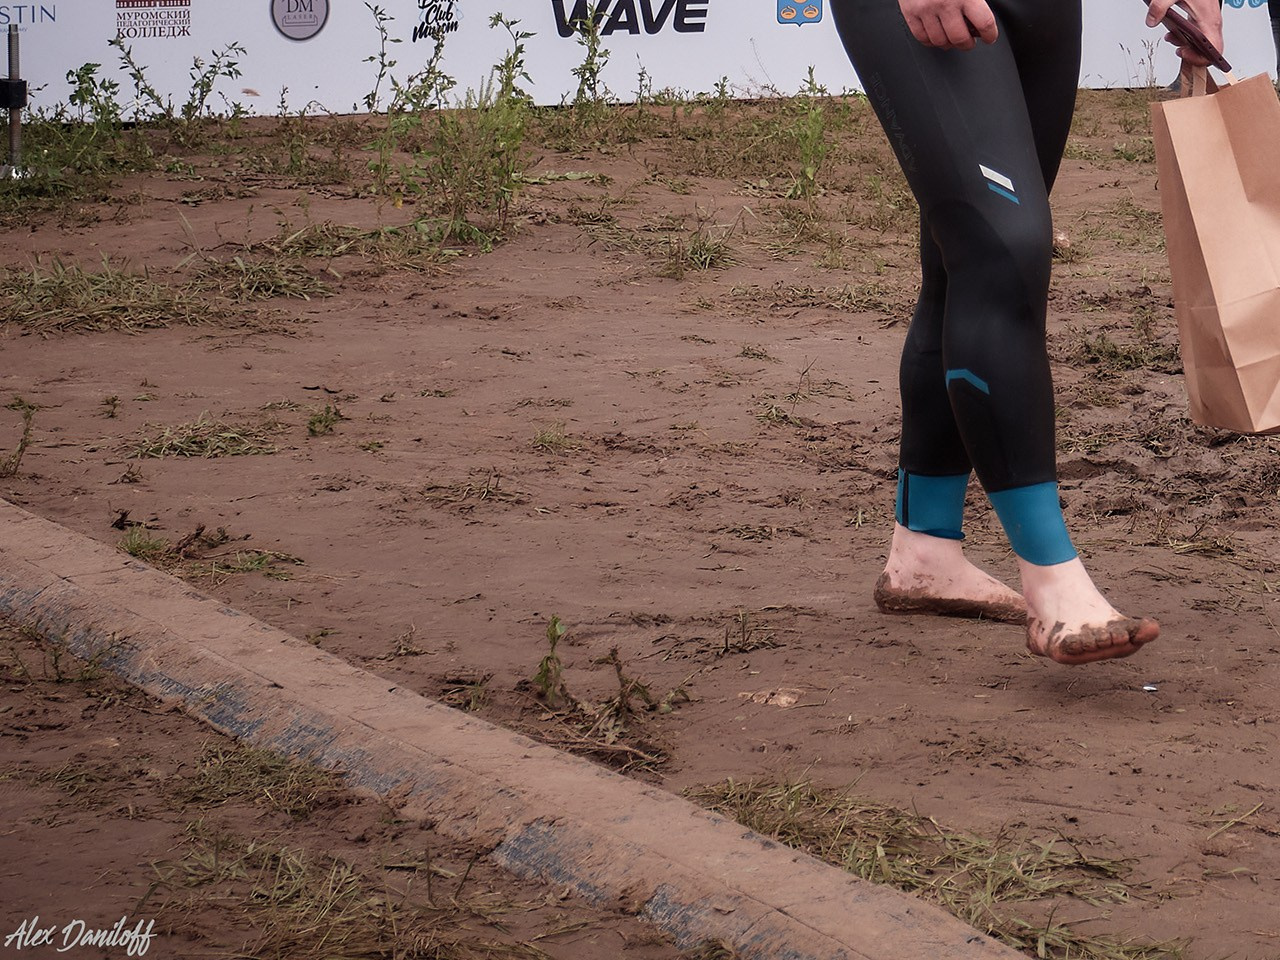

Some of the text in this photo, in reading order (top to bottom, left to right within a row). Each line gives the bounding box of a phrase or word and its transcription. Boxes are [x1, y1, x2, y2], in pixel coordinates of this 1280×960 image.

[116, 9, 191, 21] МУРОМСКИЙ
[425, 2, 454, 25] Club
[116, 18, 191, 28] ПЕДАГОГИЧЕСКИЙ
[117, 26, 191, 38] КОЛЛЕДЖ
